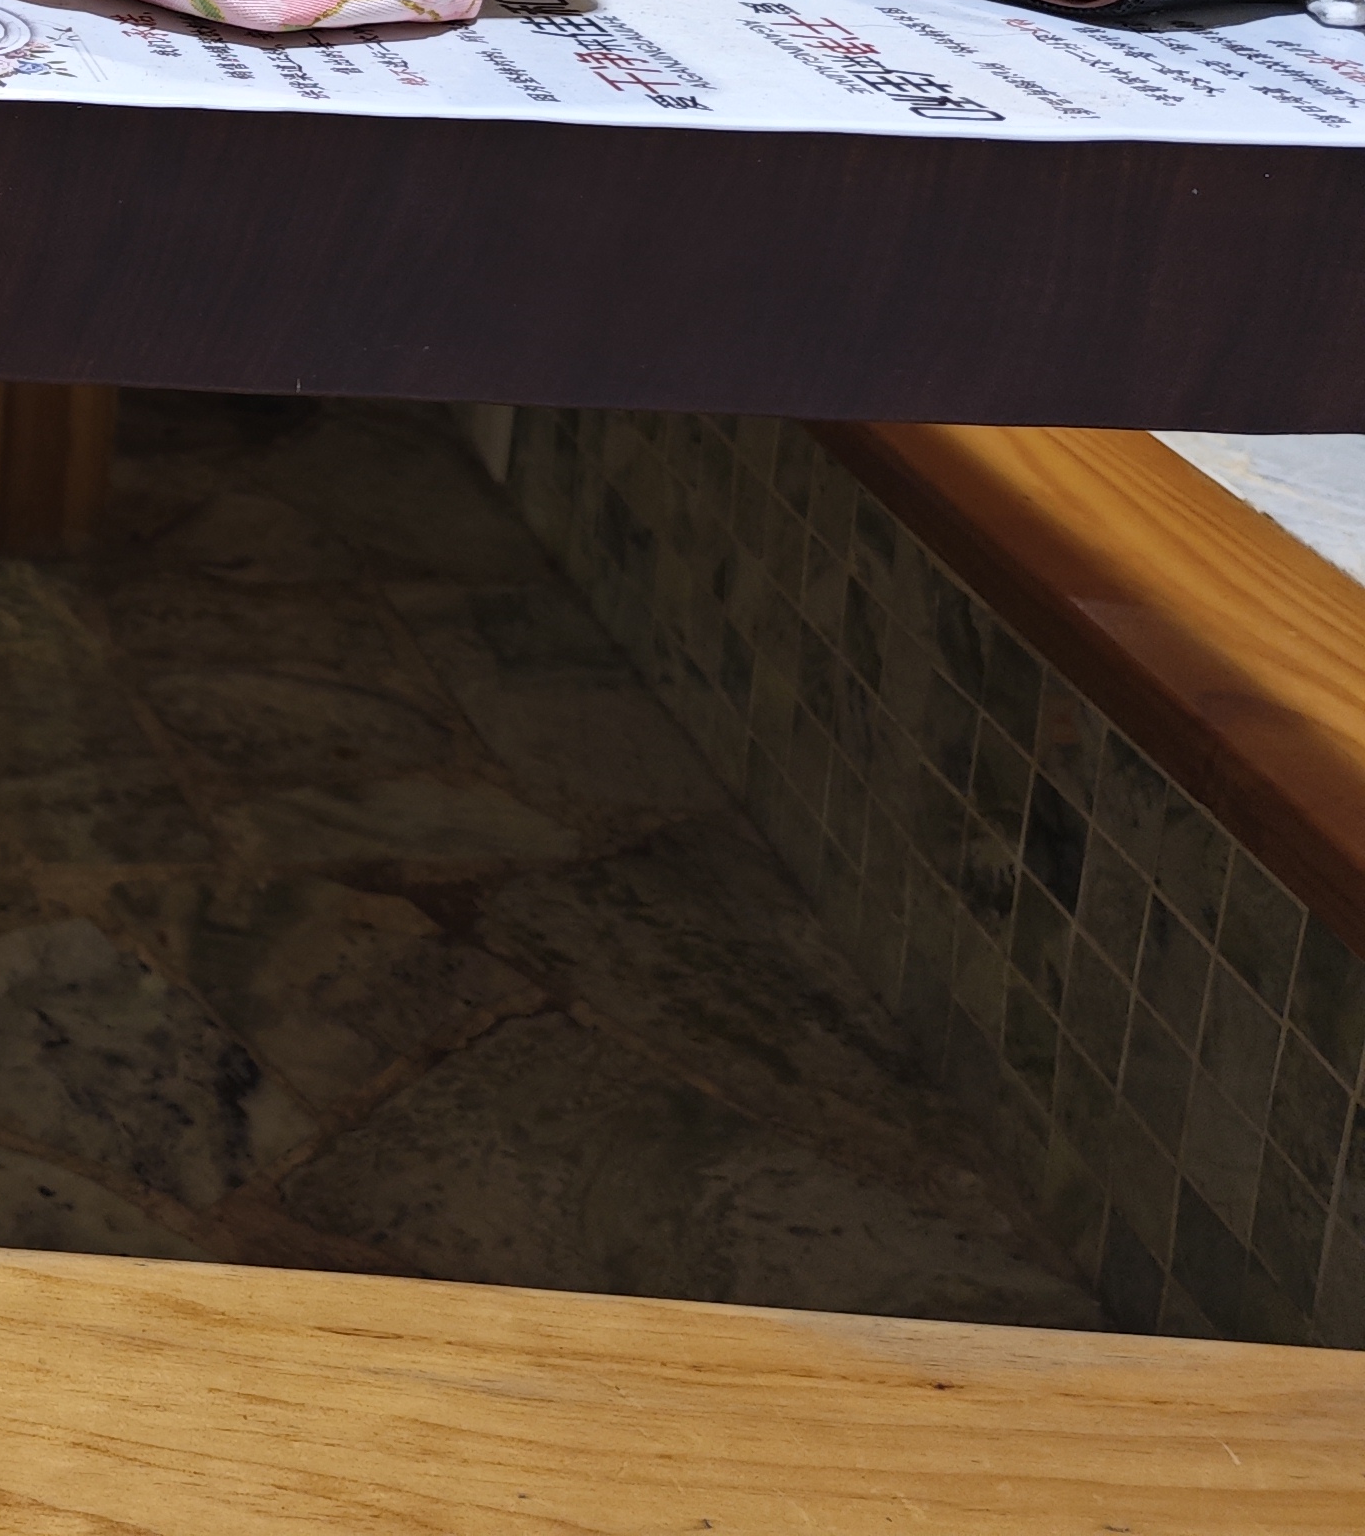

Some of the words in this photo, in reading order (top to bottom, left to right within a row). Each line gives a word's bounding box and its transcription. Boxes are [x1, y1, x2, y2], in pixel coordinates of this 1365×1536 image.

[738, 1, 1007, 122] 爱干净来佳和
